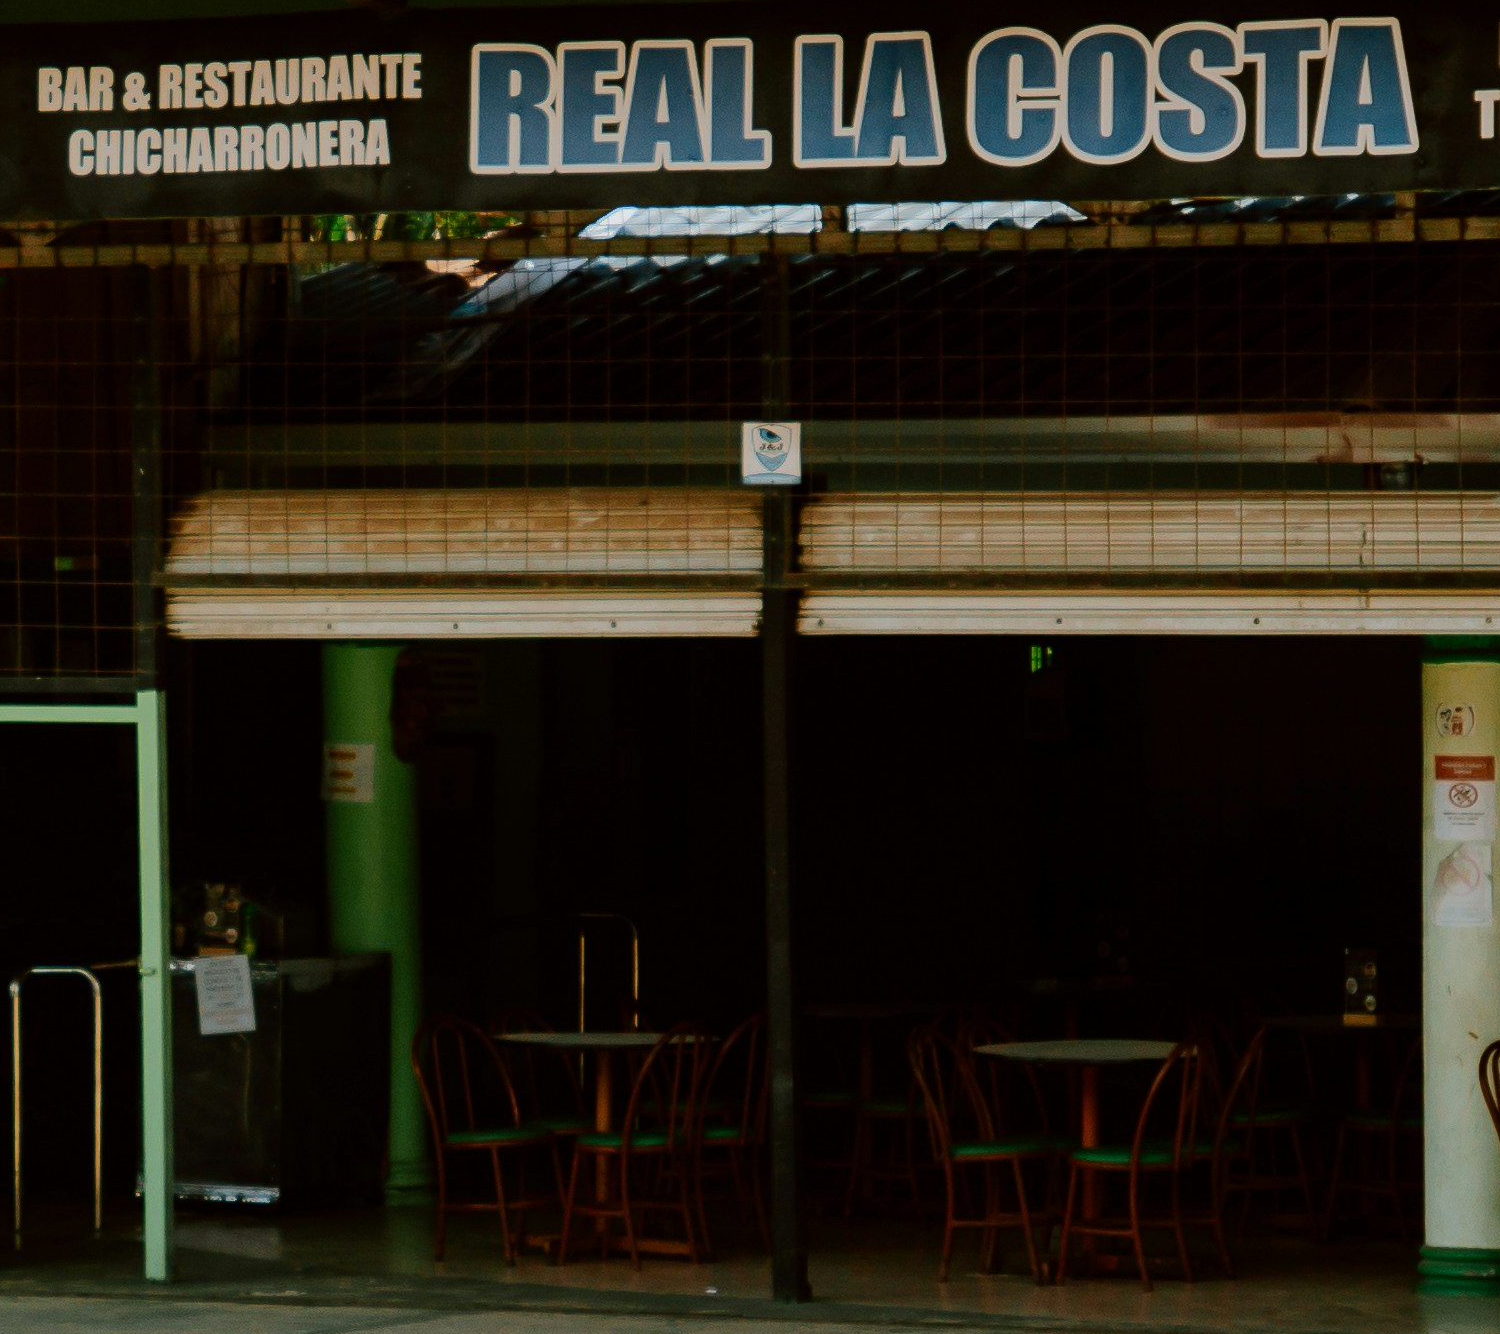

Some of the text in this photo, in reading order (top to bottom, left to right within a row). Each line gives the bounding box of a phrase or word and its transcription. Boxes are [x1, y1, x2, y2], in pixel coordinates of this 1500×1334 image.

[38, 52, 423, 113] BAR & RESTAURANTE
[469, 17, 1420, 174] REAL LA COSTA
[67, 117, 391, 176] CHICHARRONERA
